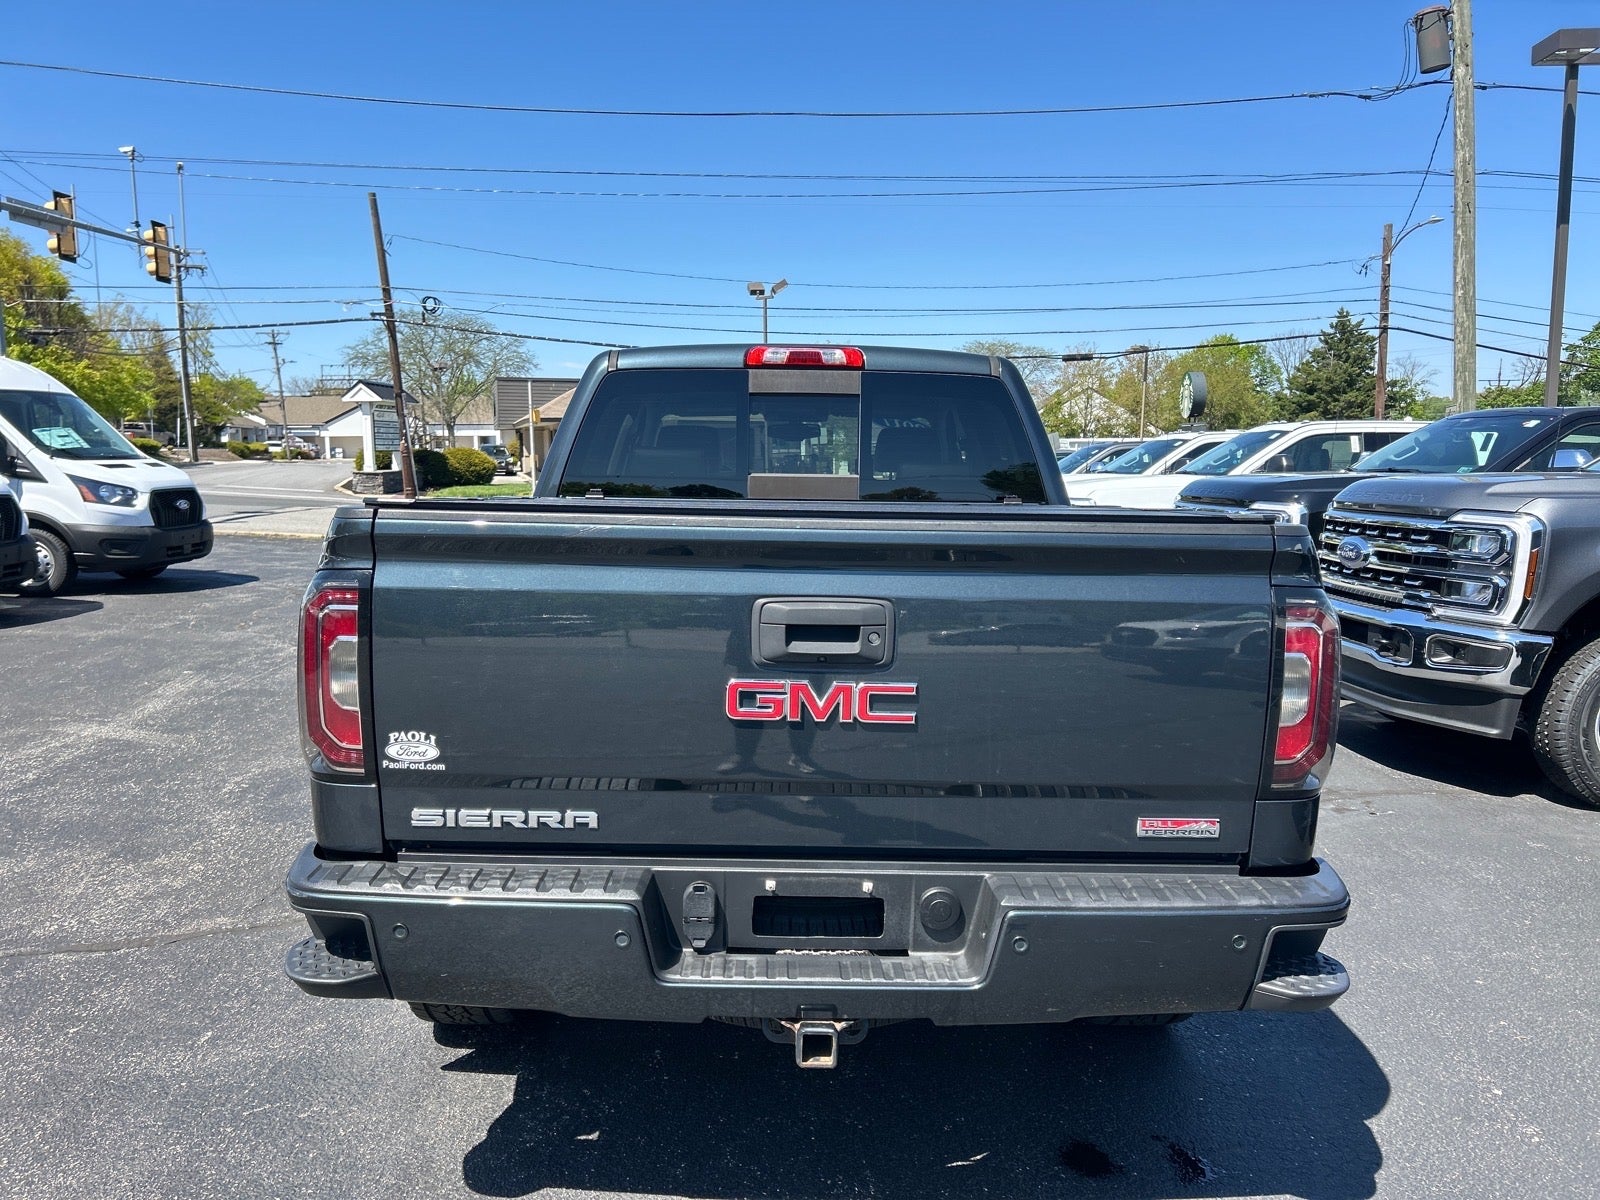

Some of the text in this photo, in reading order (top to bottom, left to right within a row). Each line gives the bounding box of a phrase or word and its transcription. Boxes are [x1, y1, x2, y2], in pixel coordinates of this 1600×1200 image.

[726, 678, 918, 724] GMC
[388, 731, 437, 747] PAOLI
[396, 744, 429, 757] Ford
[382, 760, 446, 770] PaoliFord.com
[411, 807, 599, 829] SIERRA
[1145, 820, 1178, 829] ALL
